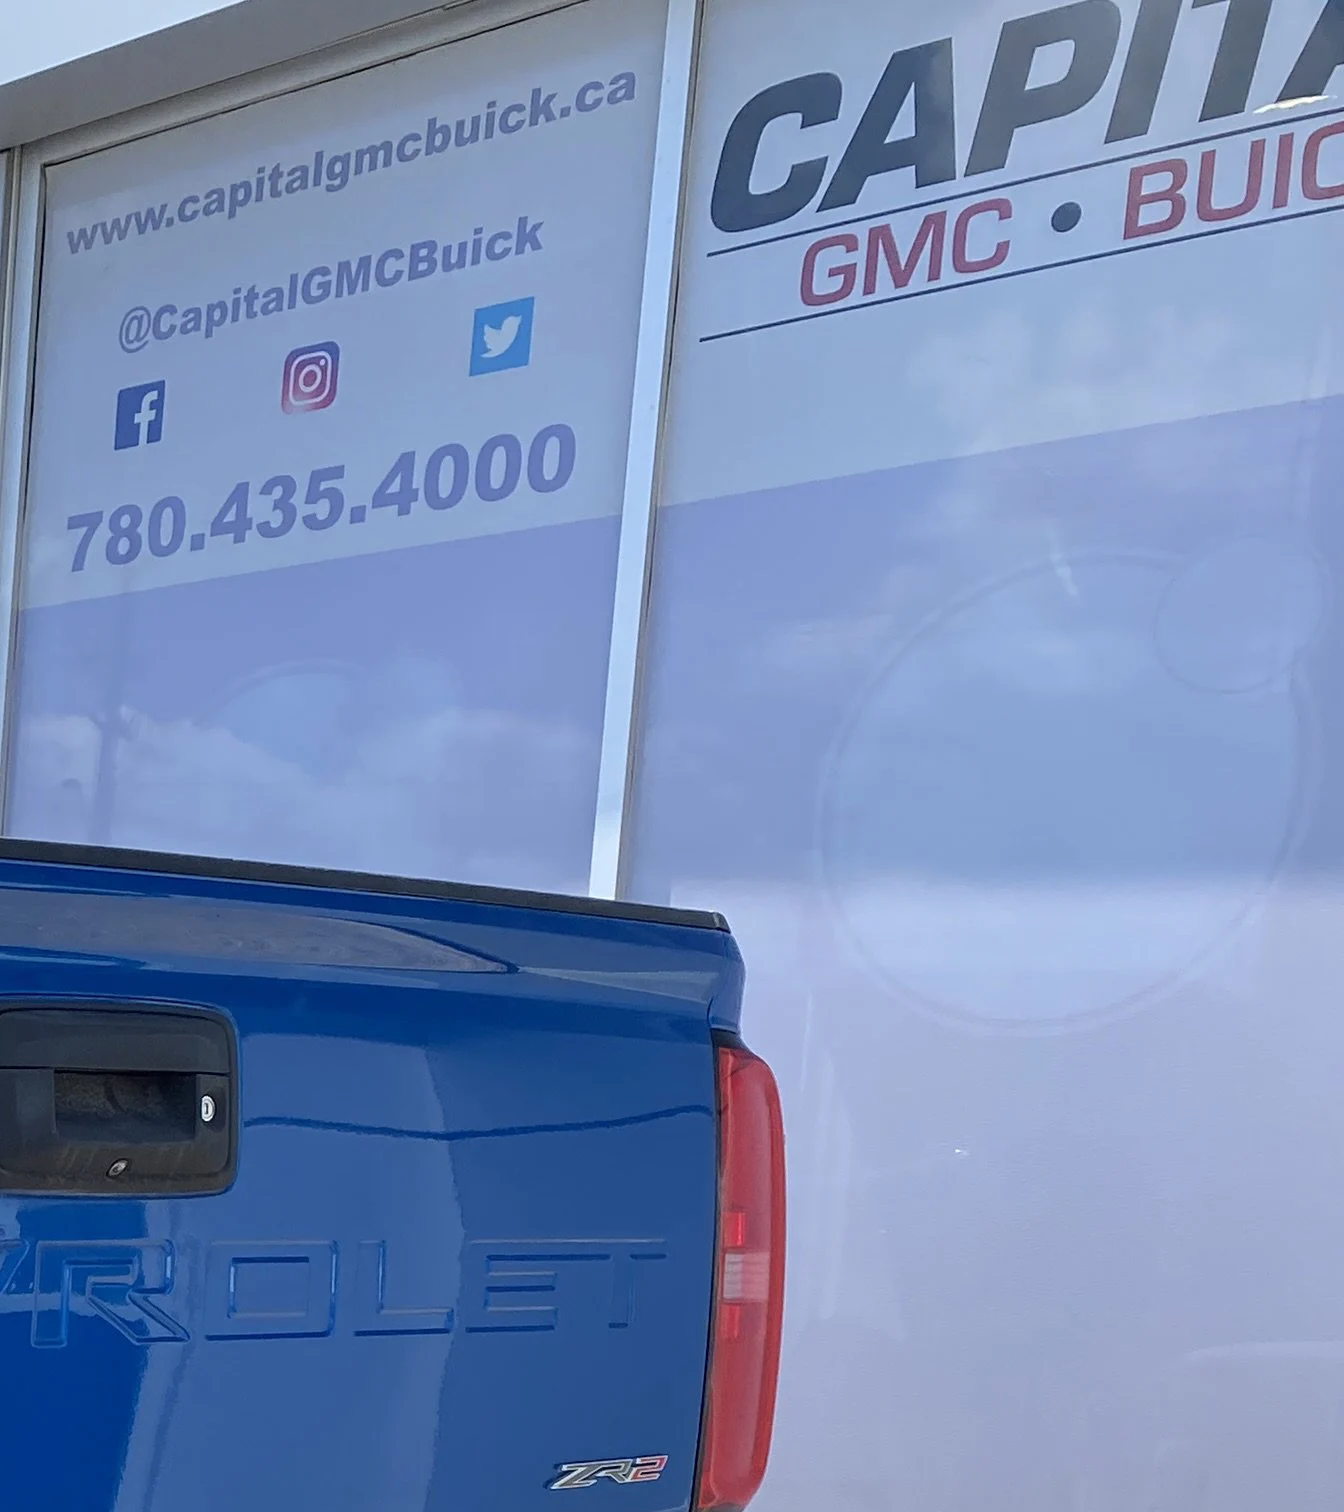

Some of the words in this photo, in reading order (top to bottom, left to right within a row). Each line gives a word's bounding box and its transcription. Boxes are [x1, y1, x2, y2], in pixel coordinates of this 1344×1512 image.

[66, 71, 637, 254] www.capitalgmcbuick.ca
[800, 198, 1013, 306] GMC
[1123, 121, 1344, 240] BUIC
[118, 216, 545, 353] @CapitalGMCBuick
[66, 423, 577, 573] 780.435.4000
[549, 1454, 669, 1490] ZR2
